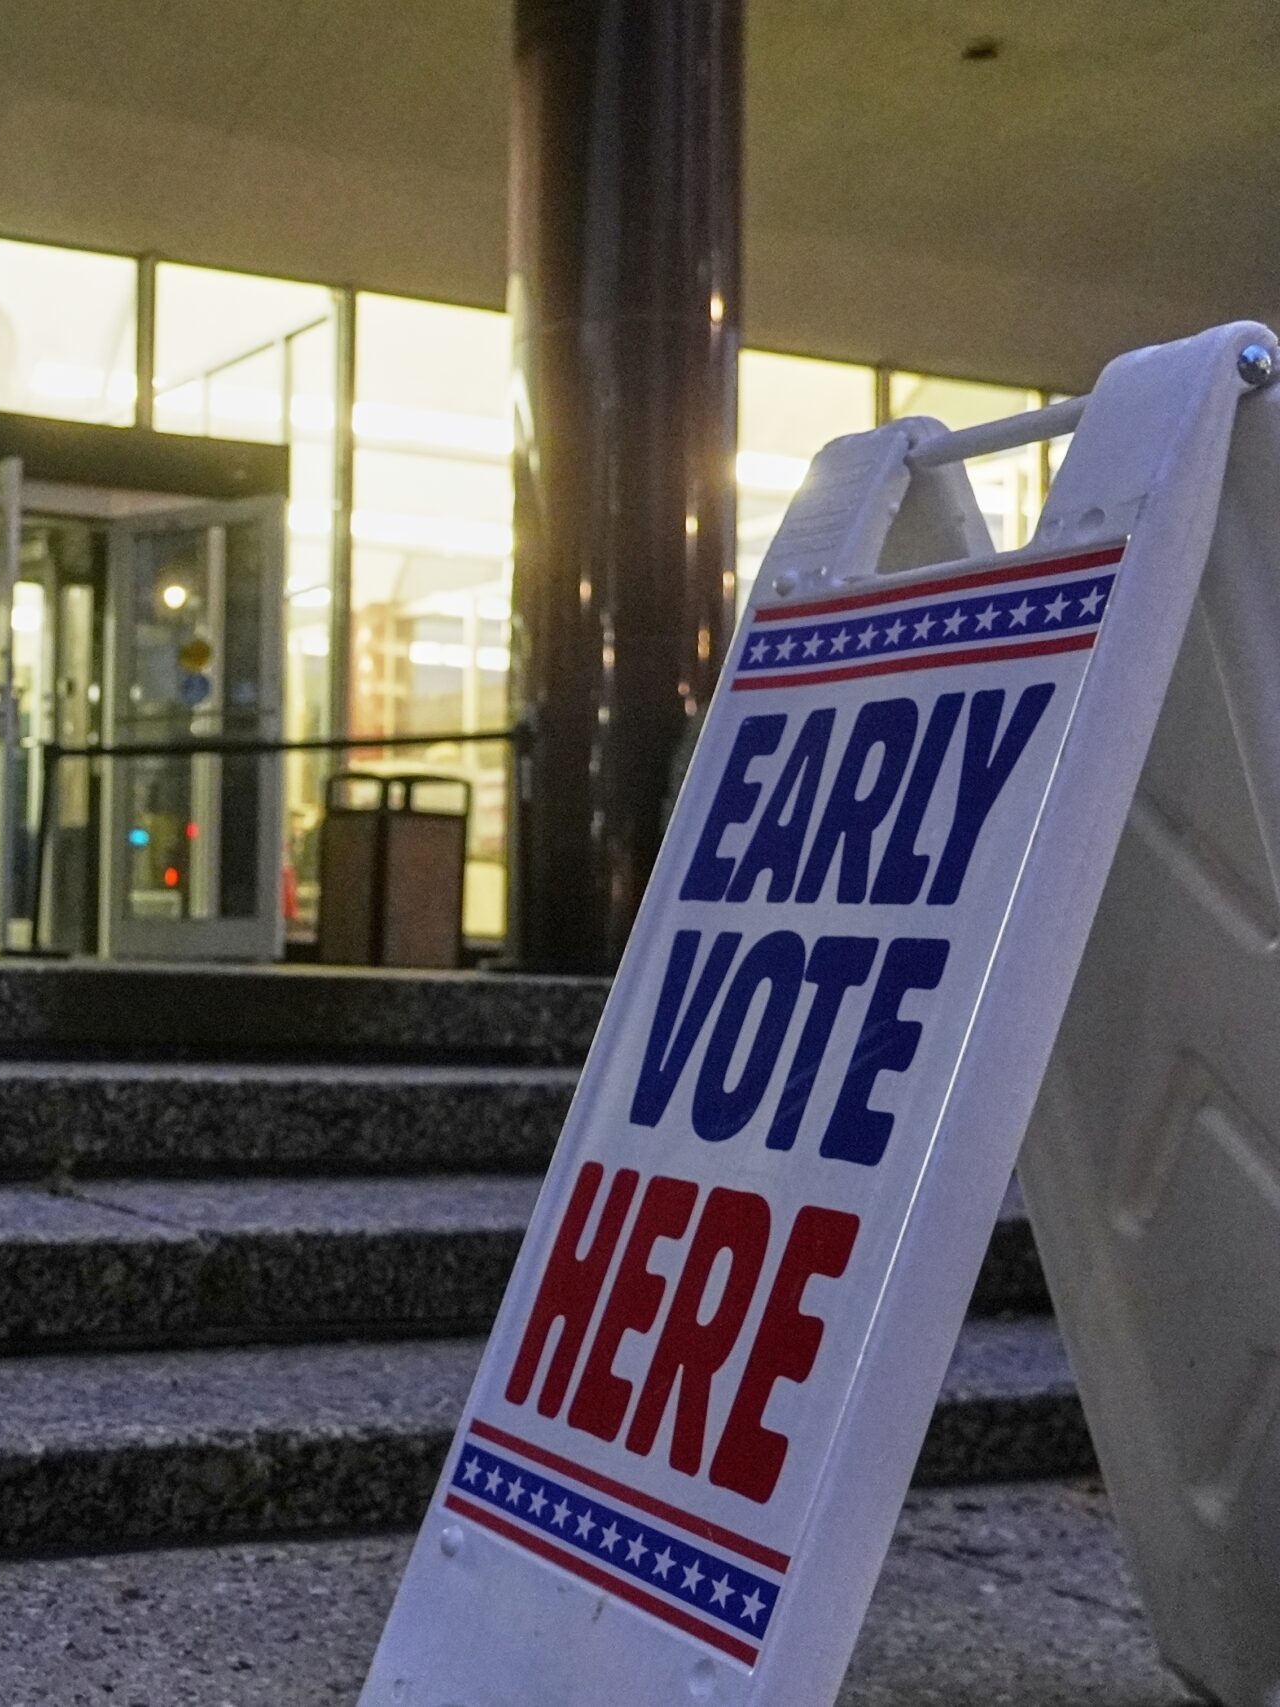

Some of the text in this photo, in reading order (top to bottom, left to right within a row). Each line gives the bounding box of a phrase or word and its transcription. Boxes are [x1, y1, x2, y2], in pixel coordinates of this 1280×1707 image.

[680, 682, 1056, 906] EARLY
[628, 928, 951, 1167] VOTE
[506, 1160, 861, 1505] HERE
